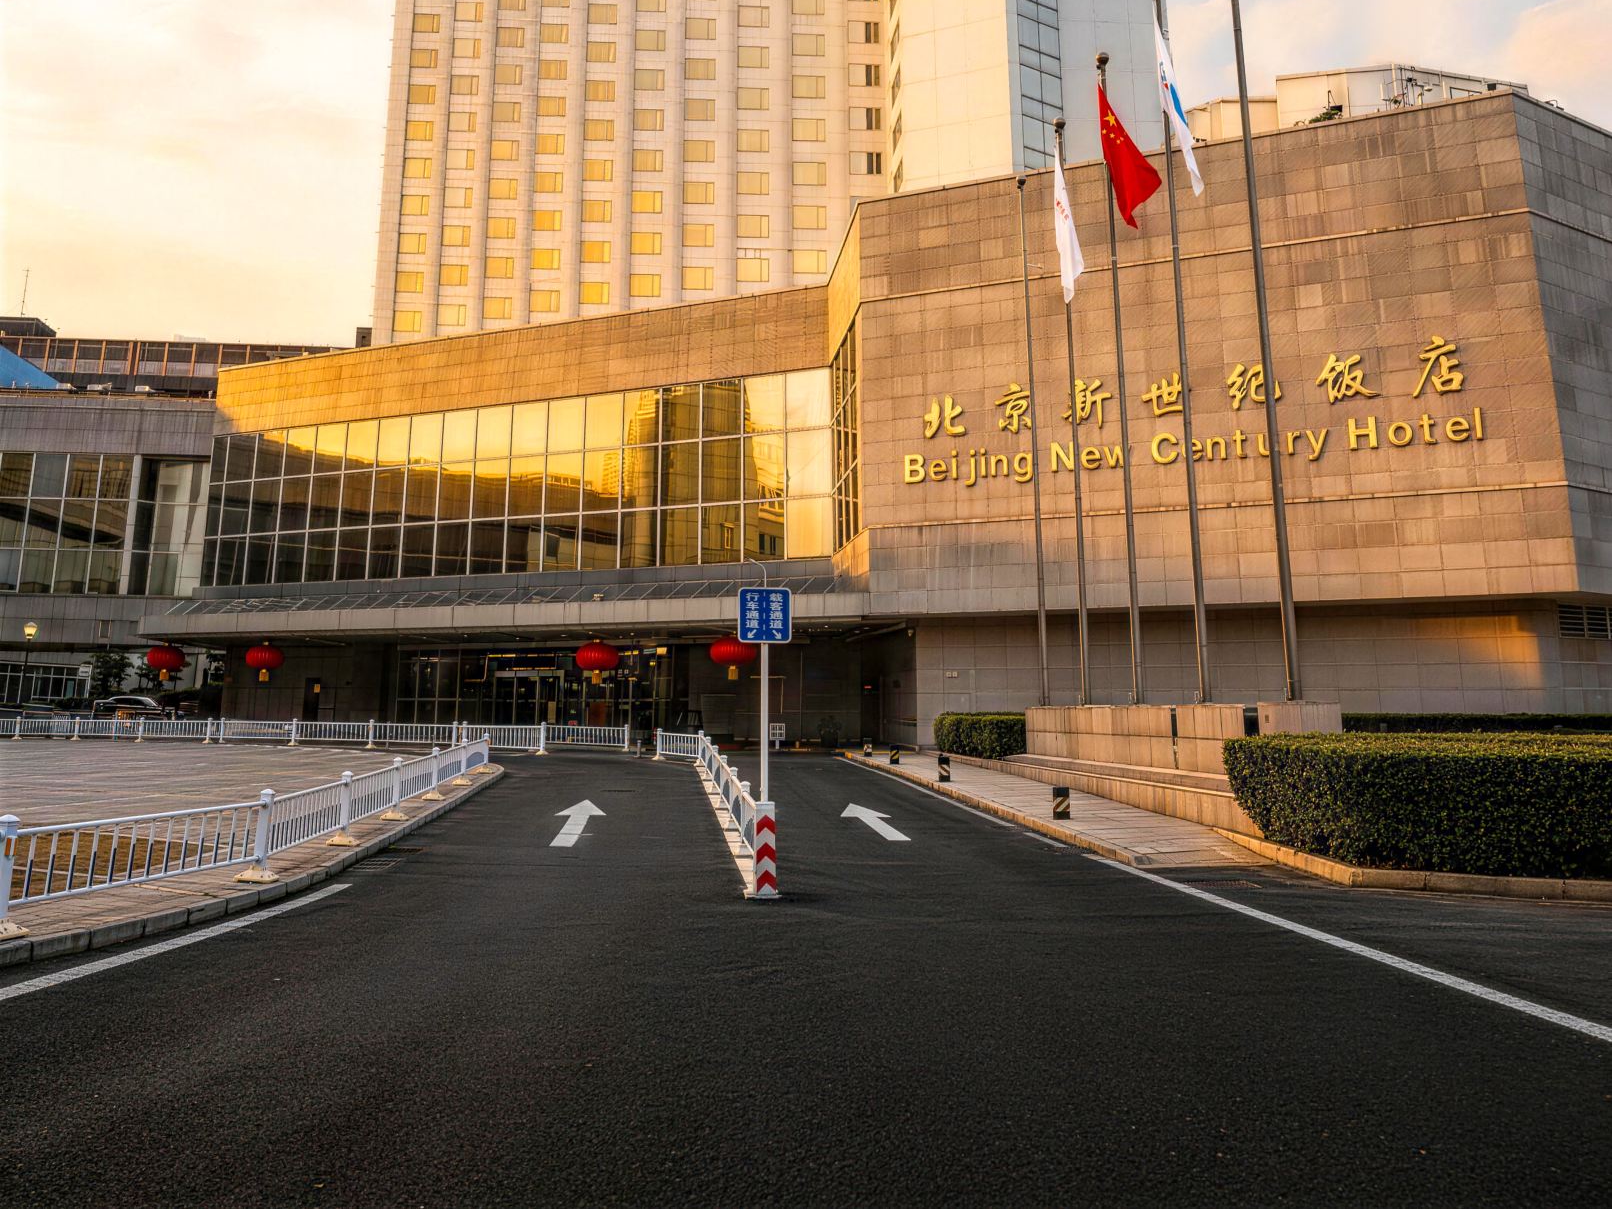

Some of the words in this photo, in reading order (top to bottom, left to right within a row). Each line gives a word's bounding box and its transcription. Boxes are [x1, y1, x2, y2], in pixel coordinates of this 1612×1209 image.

[923, 335, 1465, 439] 北京新世纪饭店
[904, 448, 1034, 486] Beijing
[1050, 441, 1131, 473] New
[1151, 428, 1328, 464] Century
[1348, 406, 1483, 451] Hotel
[745, 592, 760, 629] 行车通道
